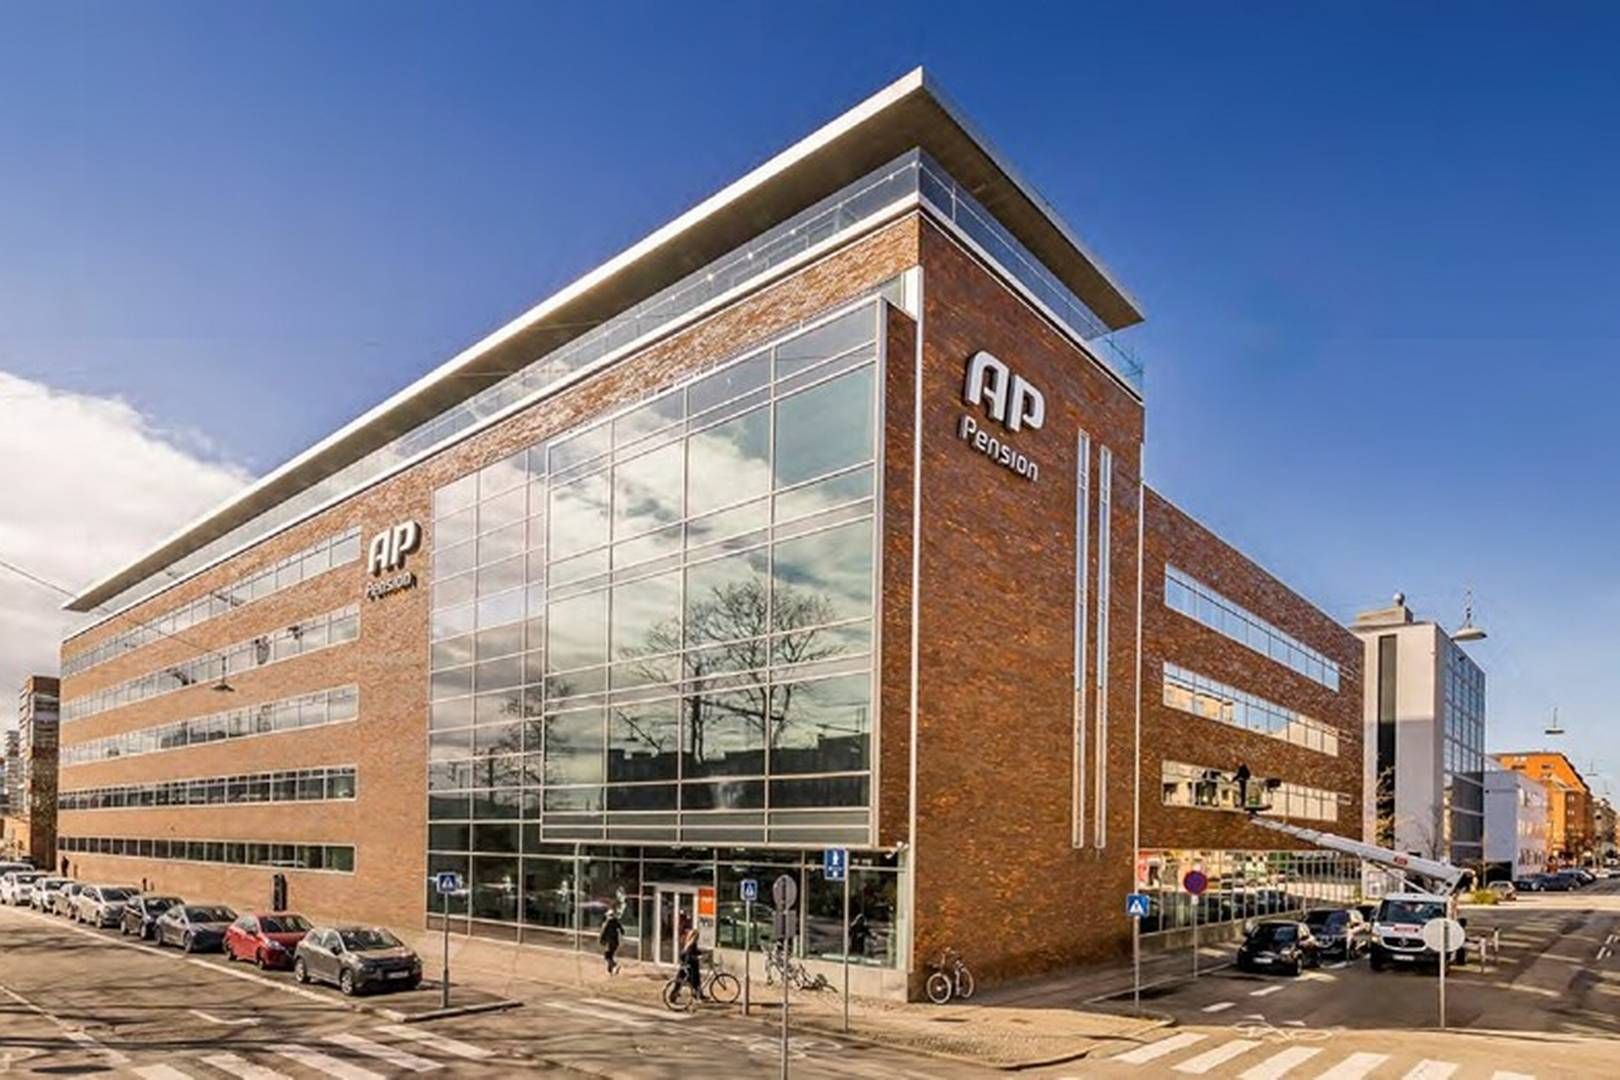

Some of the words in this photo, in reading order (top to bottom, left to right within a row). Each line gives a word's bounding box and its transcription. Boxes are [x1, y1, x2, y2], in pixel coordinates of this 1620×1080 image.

[965, 350, 1045, 432] AP
[959, 415, 1039, 482] Pension
[368, 520, 419, 574] AP
